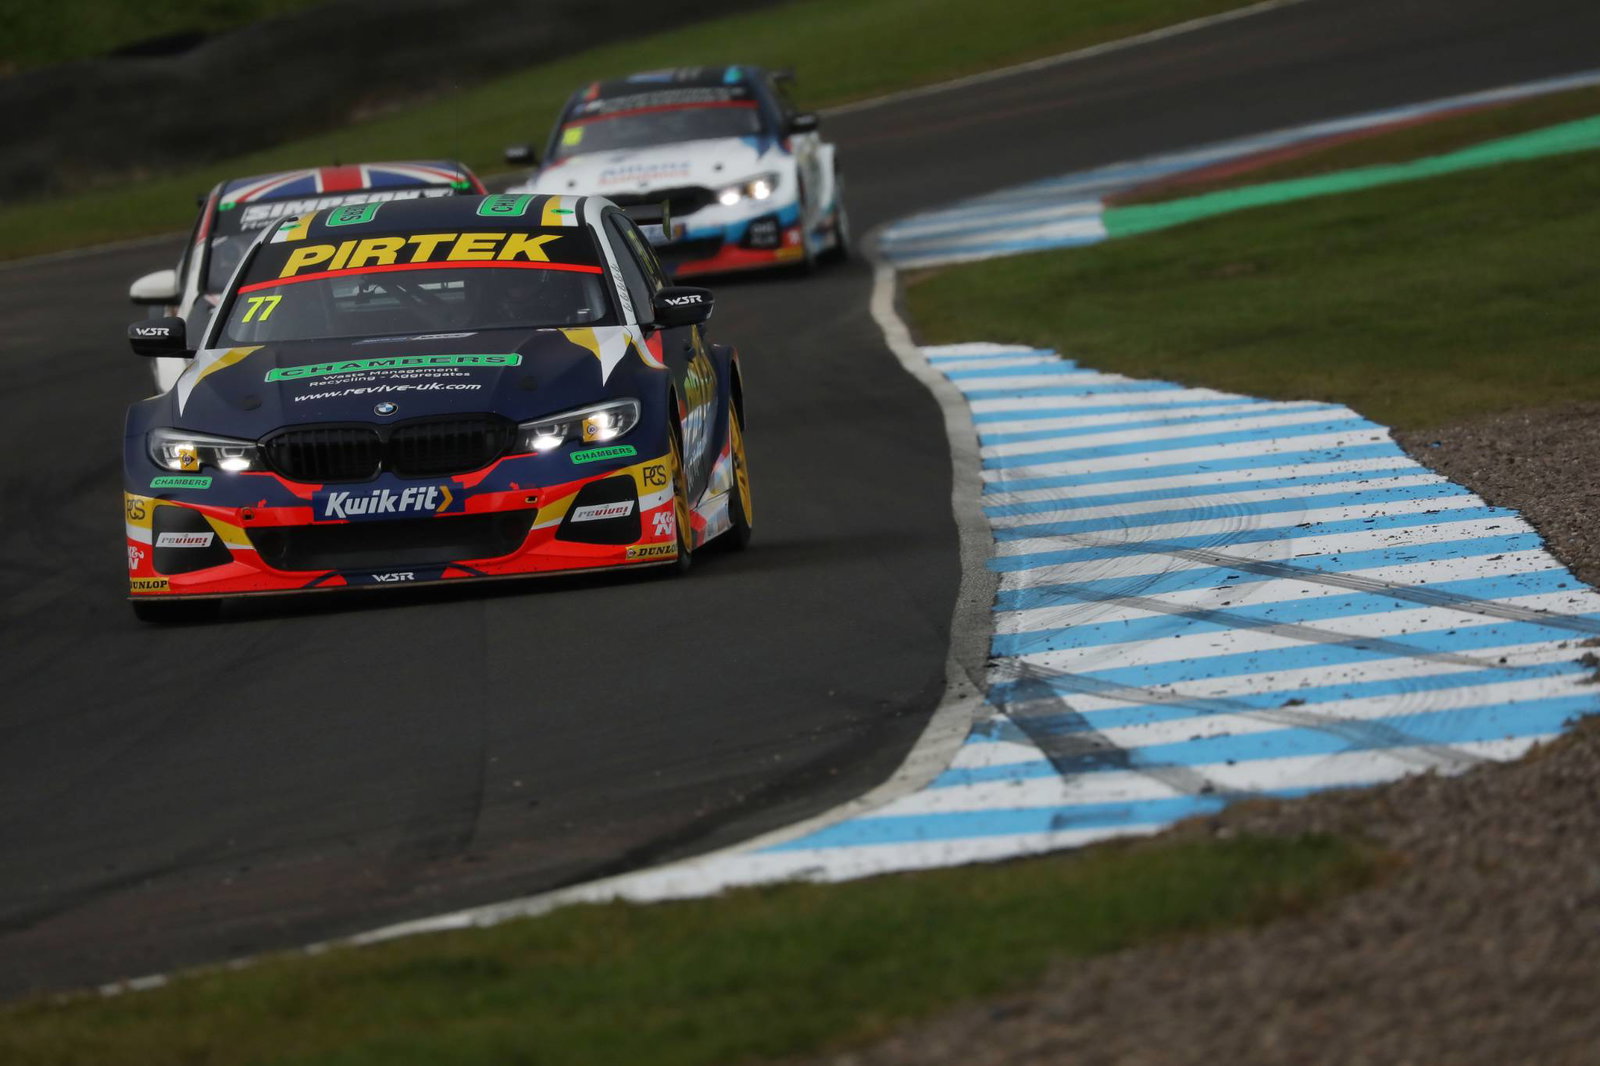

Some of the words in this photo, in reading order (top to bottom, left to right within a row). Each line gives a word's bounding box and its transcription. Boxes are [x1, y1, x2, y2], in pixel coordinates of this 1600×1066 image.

[278, 232, 564, 278] PIRTEK
[664, 294, 703, 306] WSR
[241, 295, 282, 323] 77
[135, 327, 170, 336] WSR
[280, 357, 507, 377] CHAMBERS
[323, 372, 365, 381] Waste
[369, 367, 459, 376] Management
[309, 375, 376, 387] Recycling
[390, 371, 471, 379] Aggregates
[294, 382, 482, 402] www.revive-uk.com
[575, 447, 633, 462] CHAMBERS
[637, 544, 676, 557] DUNLO
[371, 572, 415, 582] WSR
